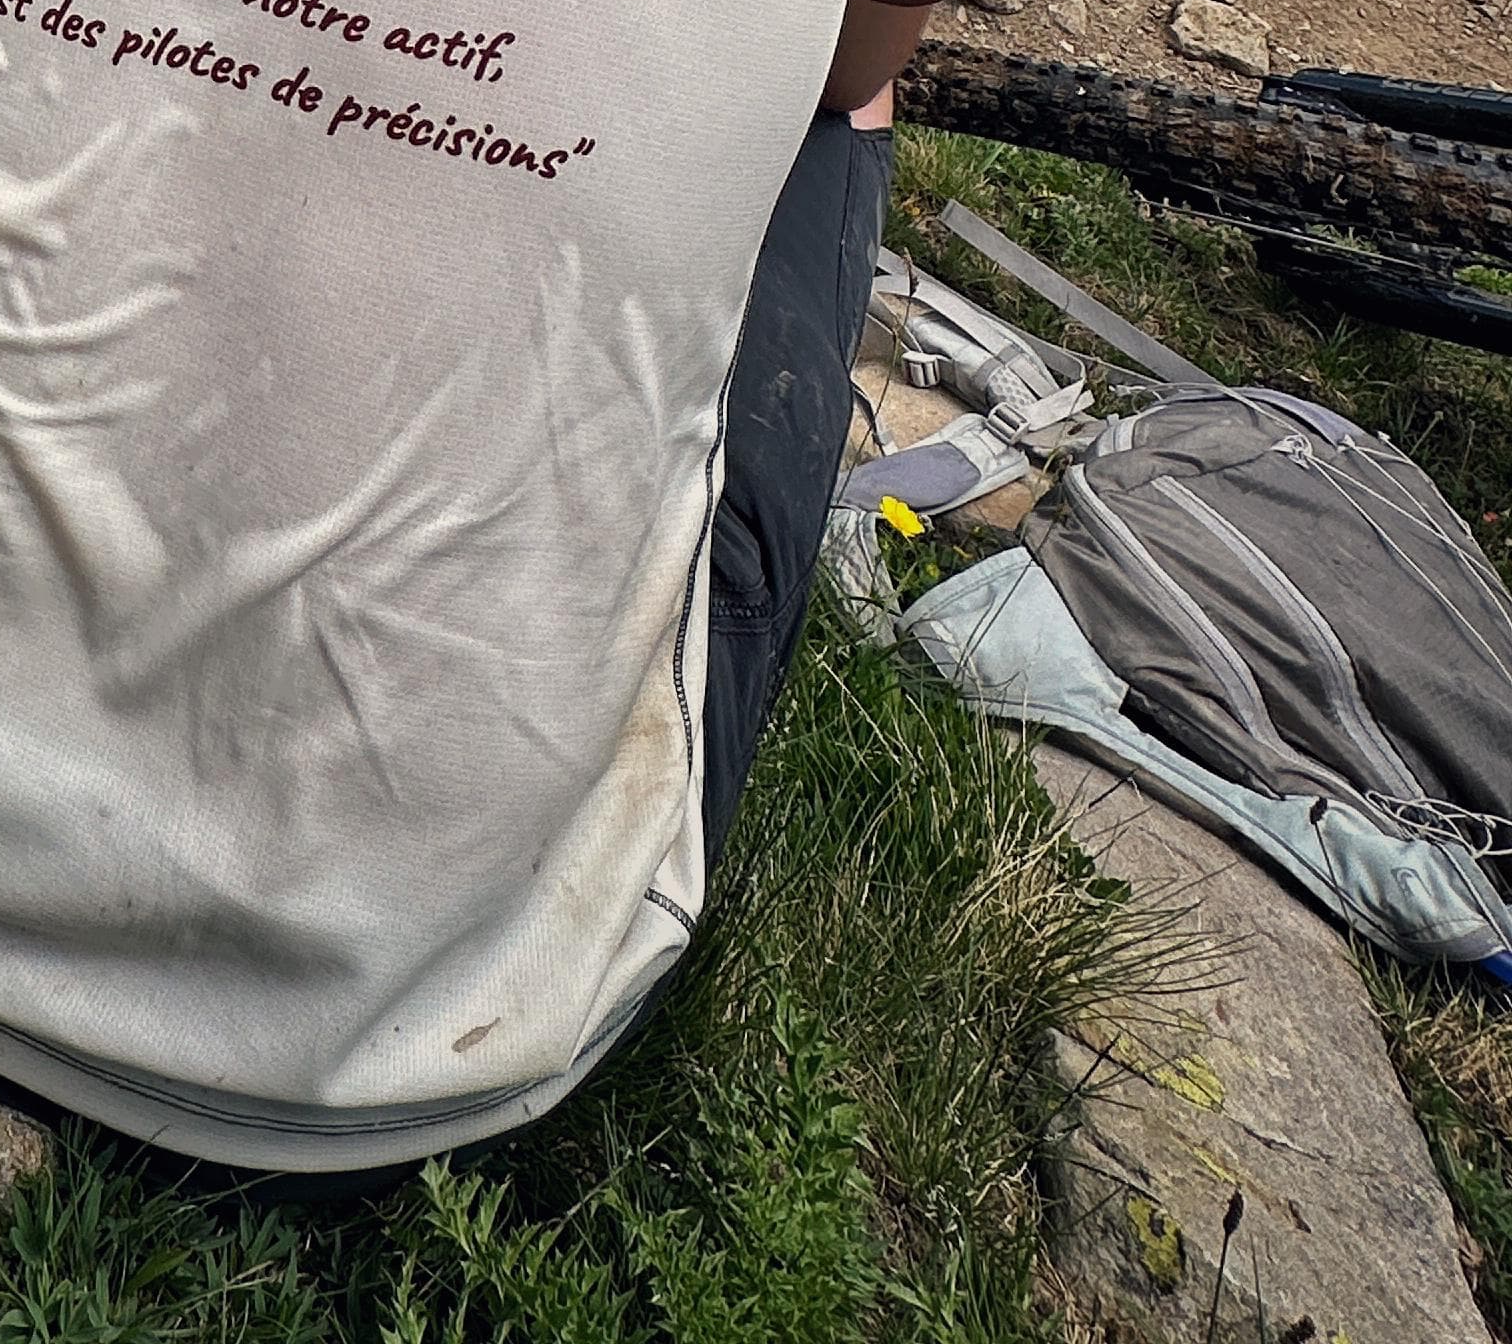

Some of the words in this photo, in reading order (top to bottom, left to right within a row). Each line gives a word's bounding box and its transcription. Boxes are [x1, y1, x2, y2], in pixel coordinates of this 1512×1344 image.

[111, 26, 261, 91] pilotes
[270, 66, 324, 113] de
[326, 94, 596, 180] précisions"
[382, 26, 516, 83] actif,
